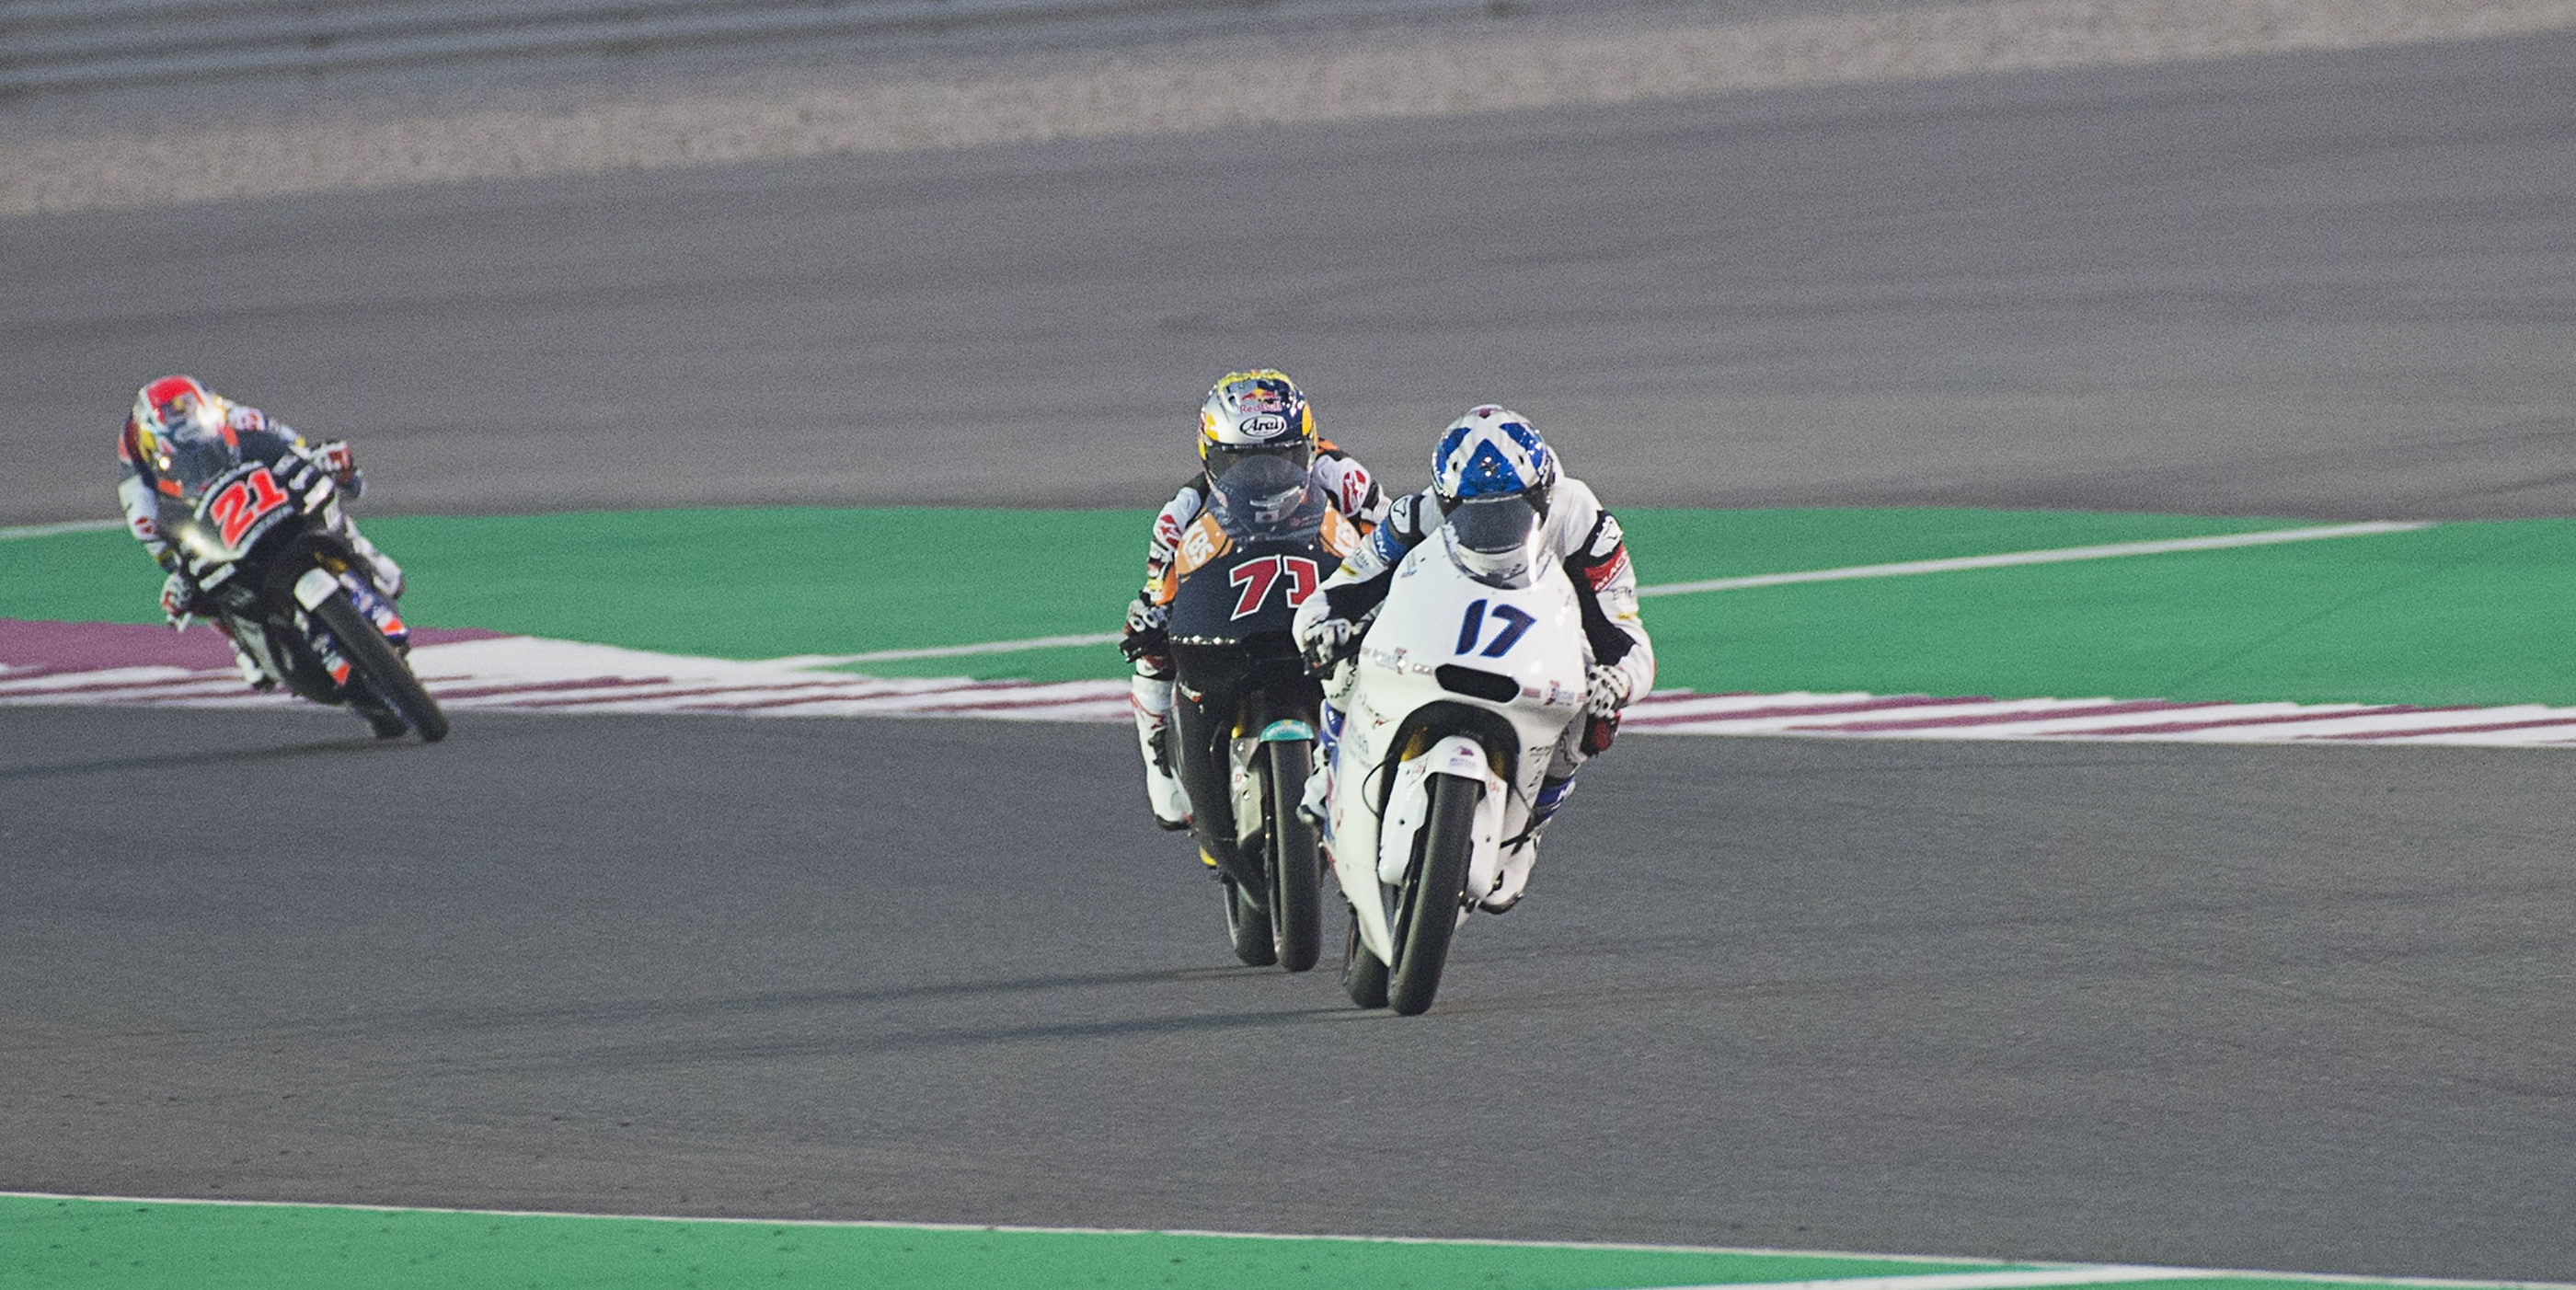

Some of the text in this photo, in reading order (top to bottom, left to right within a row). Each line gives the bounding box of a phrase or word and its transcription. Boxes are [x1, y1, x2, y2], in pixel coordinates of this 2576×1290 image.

[1243, 418, 1279, 432] Arai
[210, 467, 289, 549] 21
[1229, 553, 1320, 622] 71
[1454, 598, 1537, 658] 17
